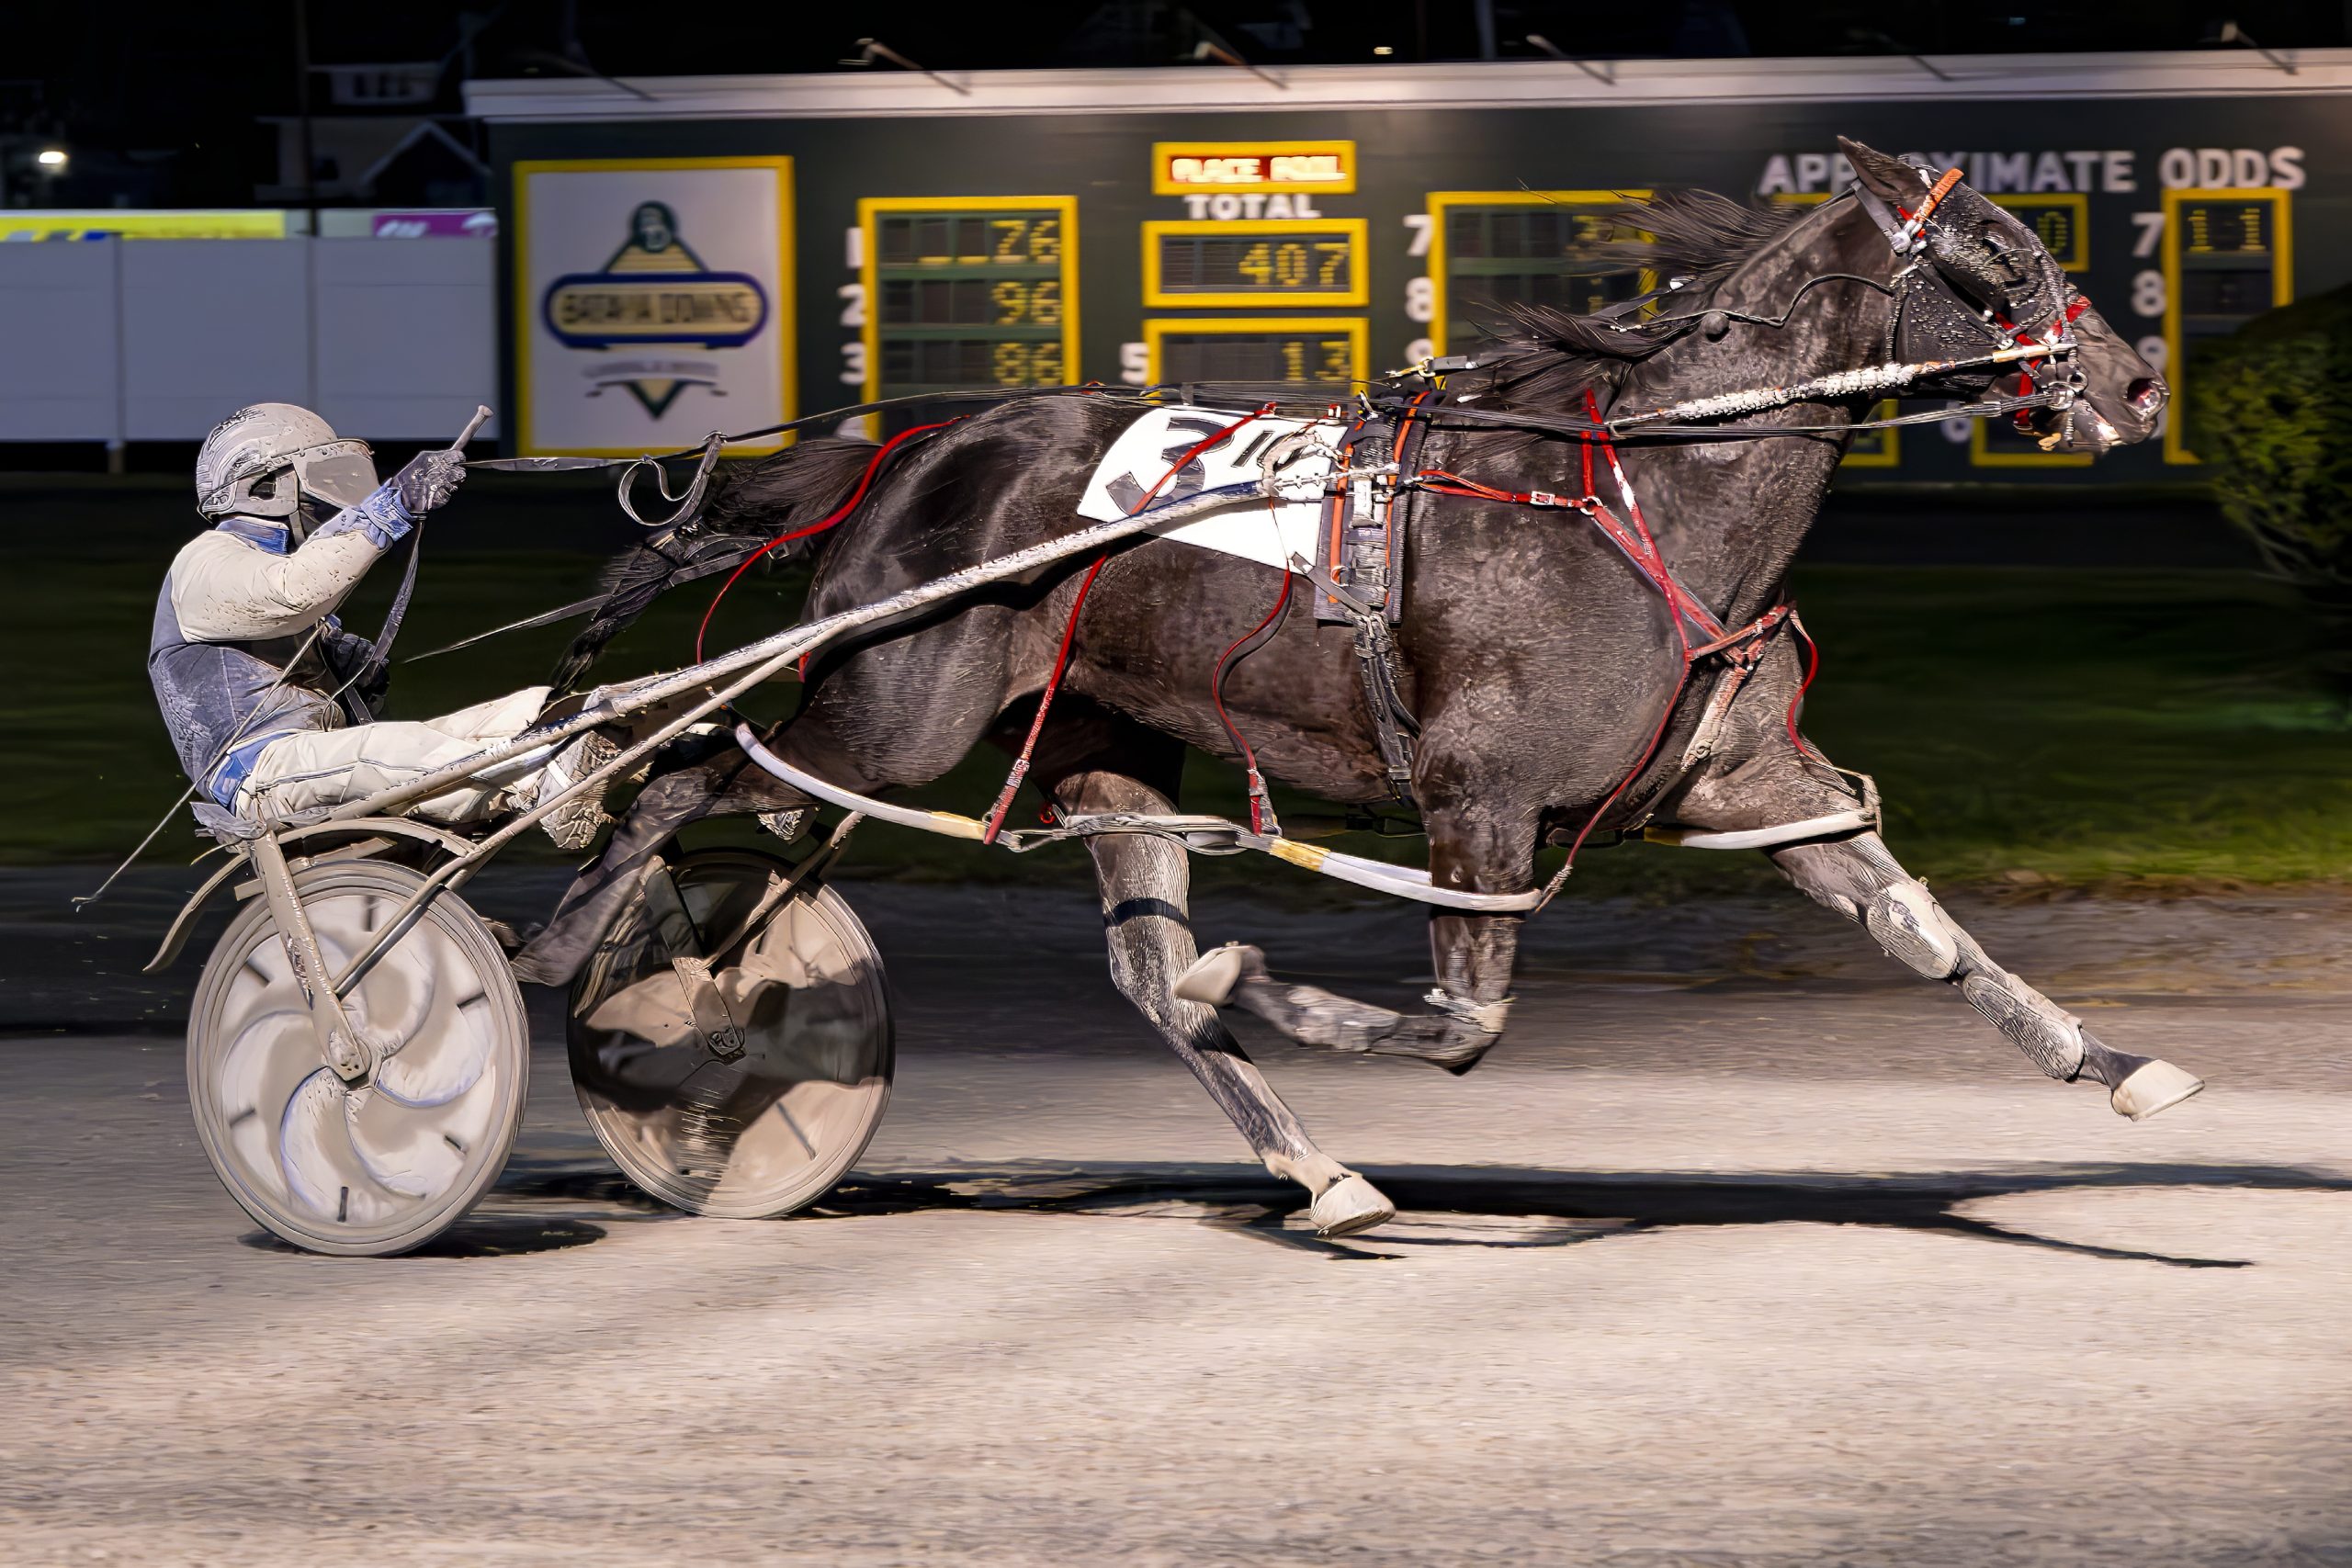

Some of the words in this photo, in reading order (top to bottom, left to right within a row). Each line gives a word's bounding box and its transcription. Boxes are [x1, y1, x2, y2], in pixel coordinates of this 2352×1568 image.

[1758, 151, 2137, 193] APPXIMATE
[2159, 147, 2306, 190] ODDS
[1182, 193, 1322, 220] TOTAL
[845, 227, 862, 268] 1
[1403, 214, 1433, 256] 7
[2131, 212, 2166, 258] 7
[1238, 243, 1349, 287] 407
[837, 283, 865, 327] 2
[990, 281, 1061, 324] 96
[1405, 276, 1433, 321] 8
[2131, 269, 2166, 318] 8
[840, 342, 866, 385] 3
[993, 342, 1062, 385] 86
[1120, 342, 1148, 384] 5
[1282, 341, 1351, 381] 13
[1105, 417, 1235, 516] 3
